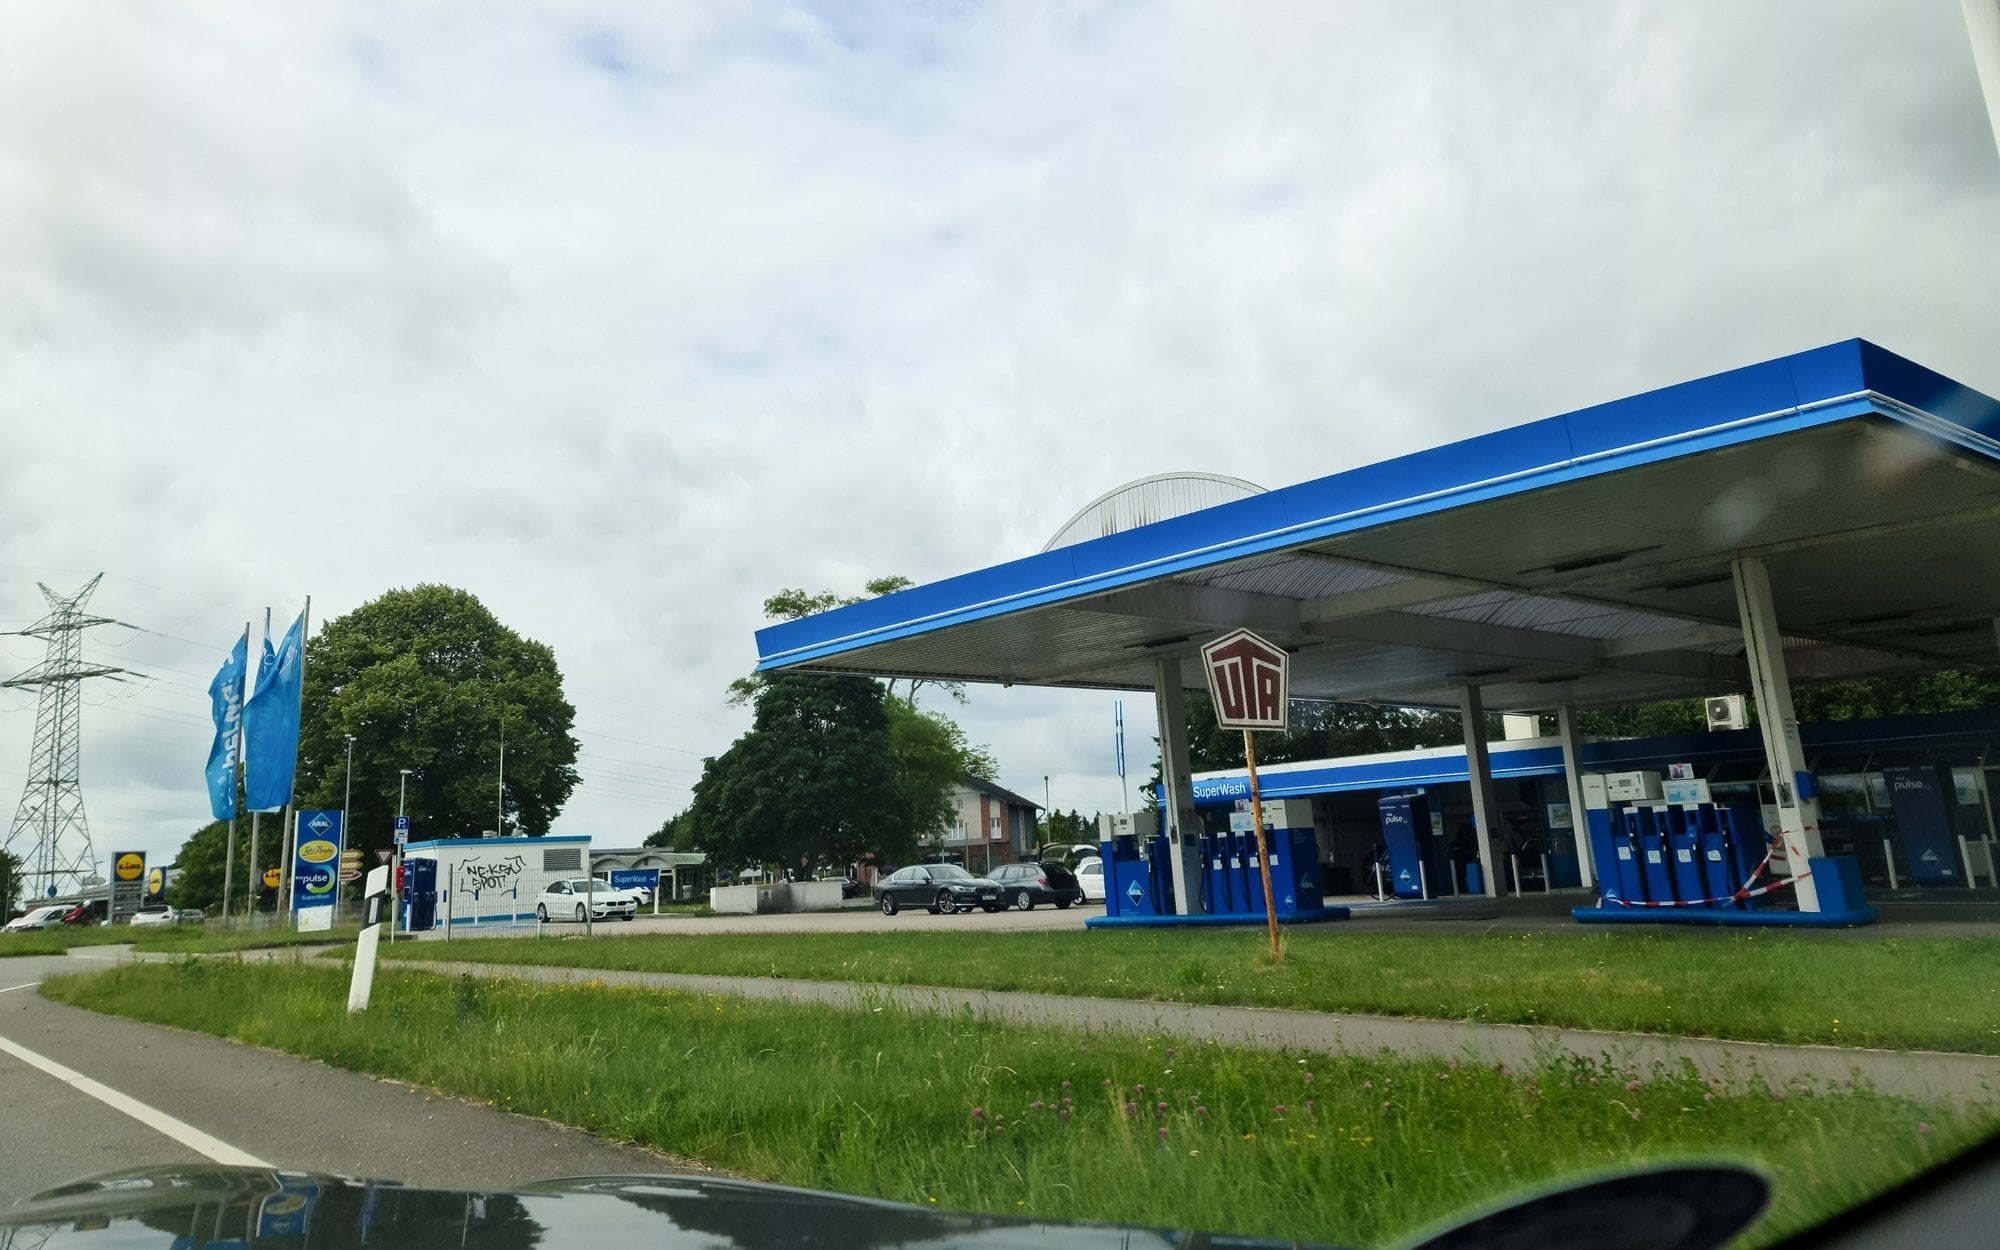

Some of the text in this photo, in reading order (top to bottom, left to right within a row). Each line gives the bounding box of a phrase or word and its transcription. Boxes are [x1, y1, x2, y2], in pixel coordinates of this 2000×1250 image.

[1211, 637, 1281, 720] UTA
[1193, 782, 1246, 799] SuperWash
[1894, 780, 1923, 791] pulse
[398, 818, 406, 828] P
[1385, 814, 1403, 825] pulse
[303, 873, 328, 885] pulse
[614, 875, 648, 883] SuperWash
